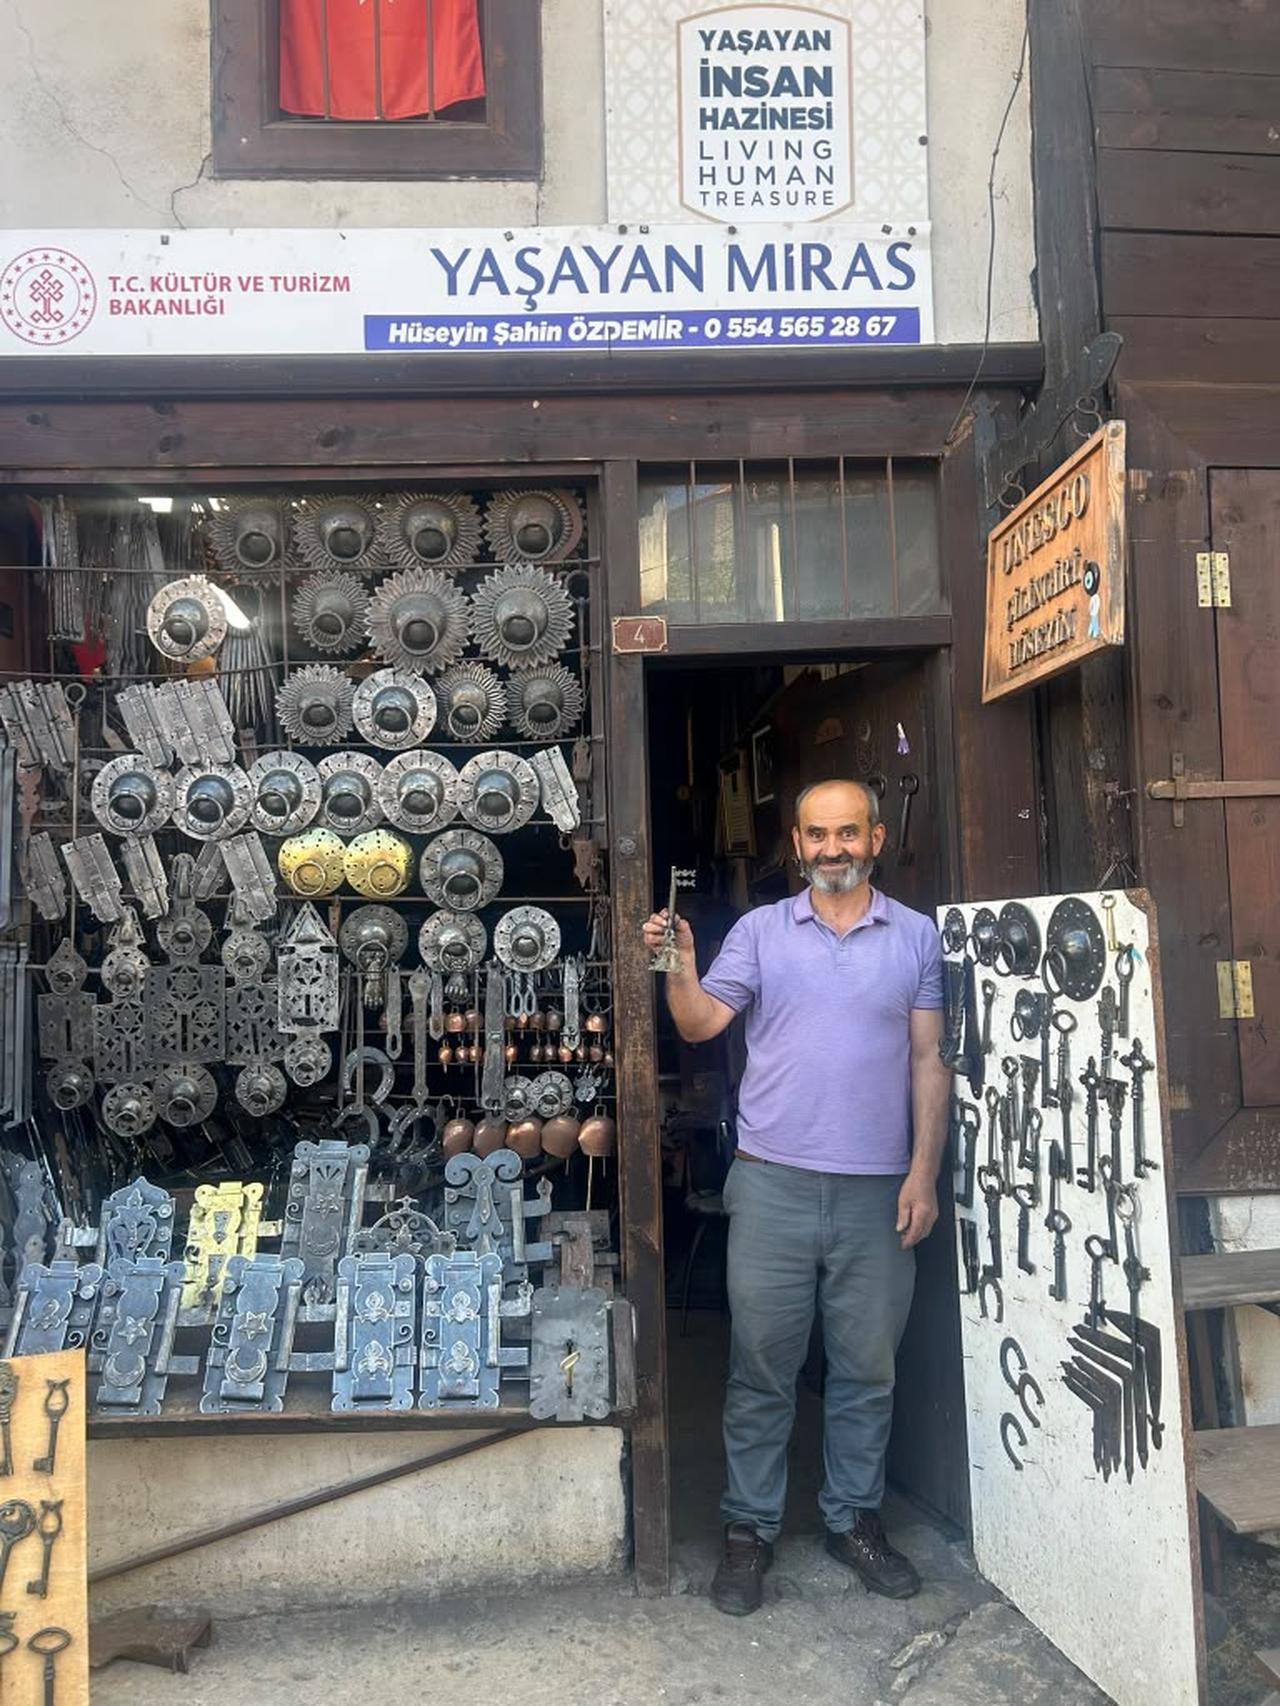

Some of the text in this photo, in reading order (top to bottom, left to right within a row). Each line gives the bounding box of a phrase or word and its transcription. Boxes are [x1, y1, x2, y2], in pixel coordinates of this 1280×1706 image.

[698, 29, 831, 55] YAŞAYAN
[699, 58, 833, 98] İNSAN
[699, 101, 833, 130] HAZİNESİ
[699, 140, 832, 160] LIVING
[699, 166, 834, 186] HUMAN
[699, 191, 834, 206] TREASURE
[108, 272, 351, 292] T.C. KÜLTÜR VE TURİZM
[429, 244, 704, 311] YAŞAYAN
[109, 296, 225, 315] BAKANLIĞI
[388, 321, 486, 346] Hüseyin
[493, 320, 562, 346] Şahin
[568, 315, 682, 341] ÖZDEMİR
[704, 318, 721, 338] 0
[726, 317, 774, 337] 554
[778, 316, 826, 337] 565
[829, 316, 860, 336] 28
[865, 316, 897, 336] 67
[1003, 474, 1088, 576] UNESCO
